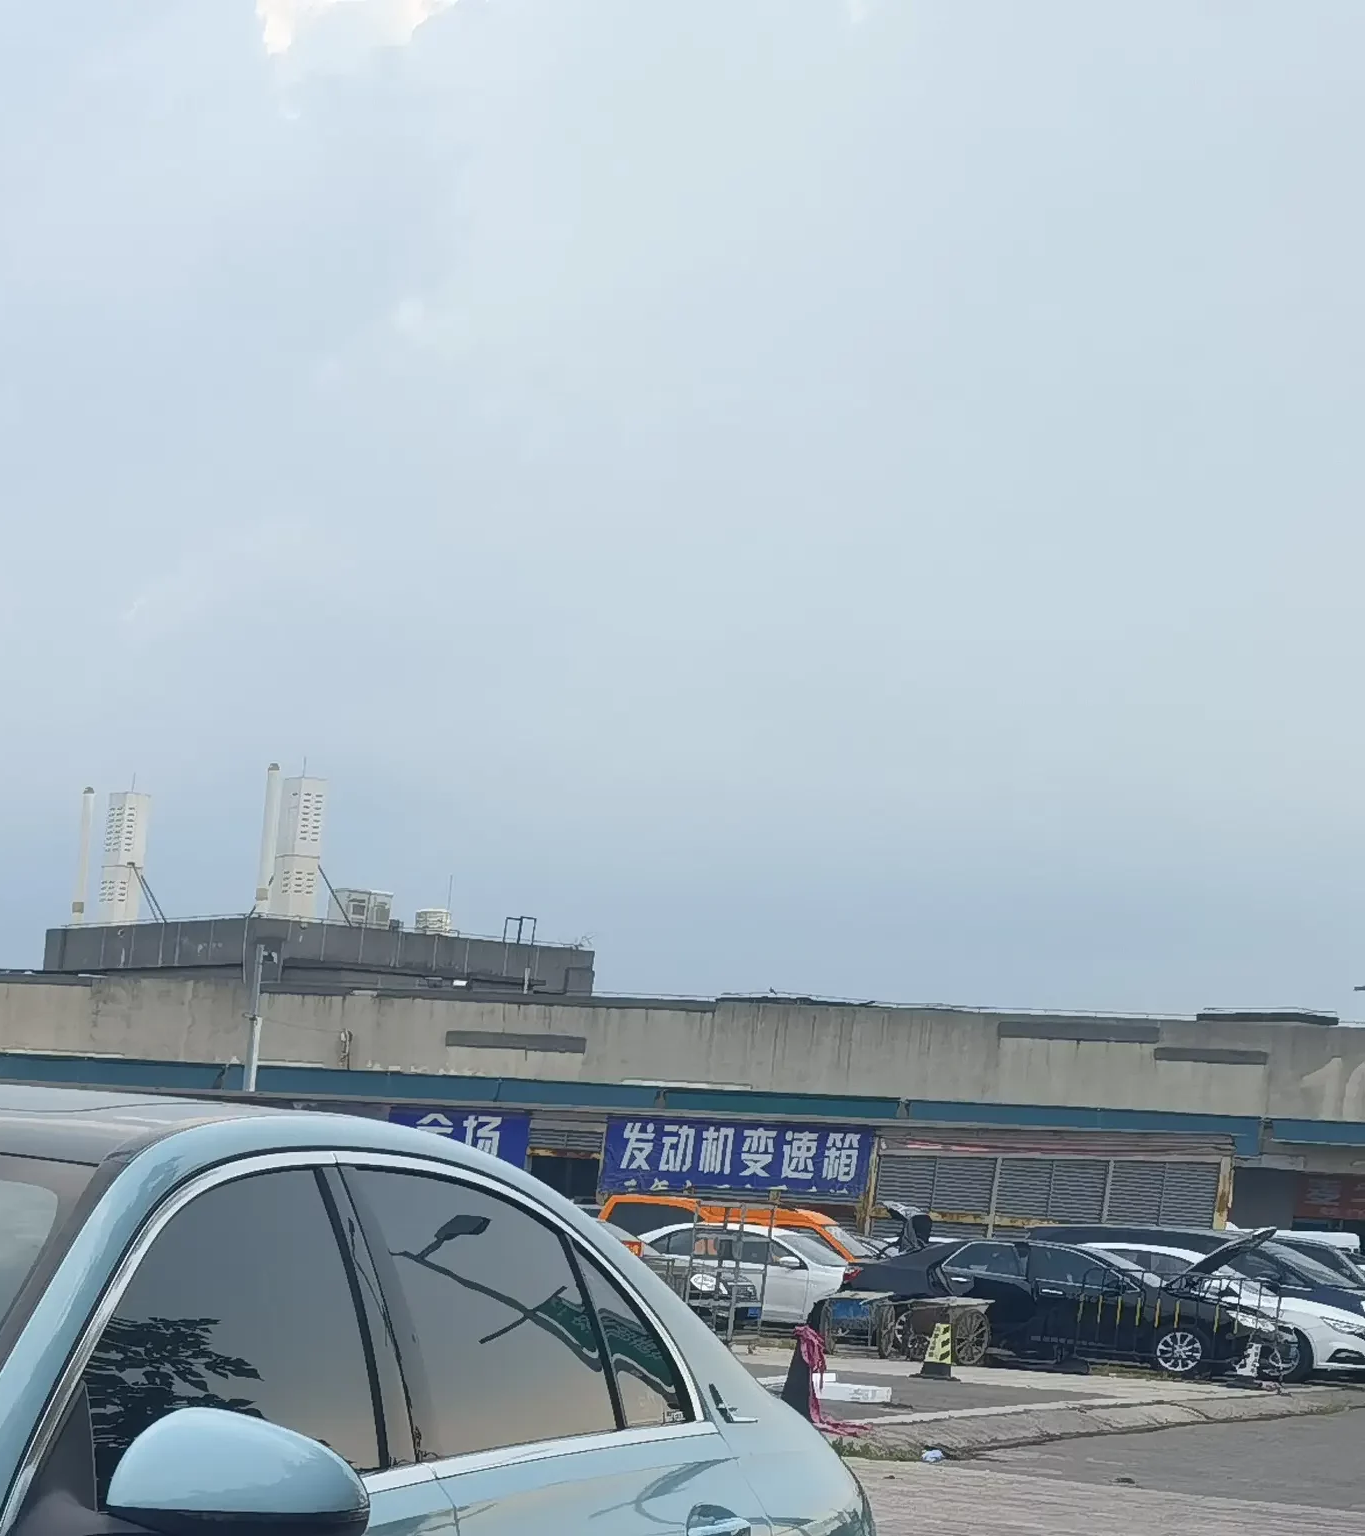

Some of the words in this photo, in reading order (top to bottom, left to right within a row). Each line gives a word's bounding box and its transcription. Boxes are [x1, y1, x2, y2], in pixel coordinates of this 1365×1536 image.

[620, 1122, 861, 1182] 发动机变速箱
